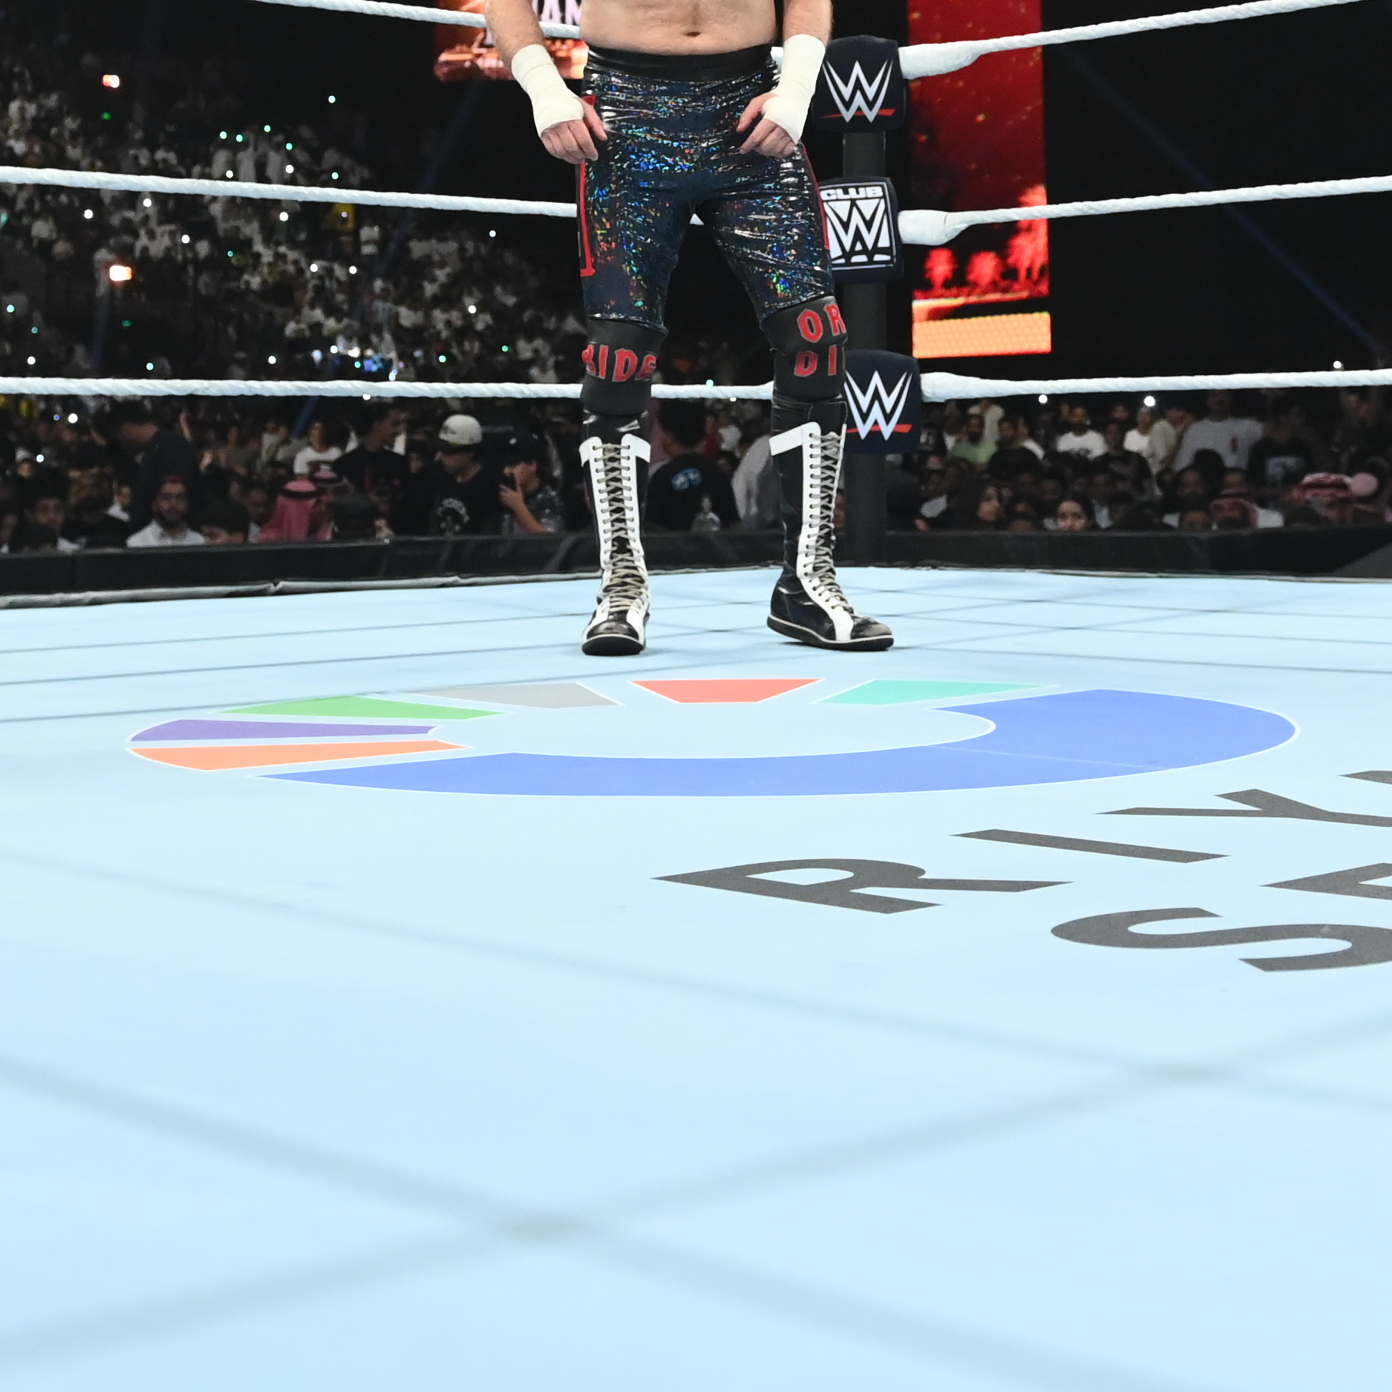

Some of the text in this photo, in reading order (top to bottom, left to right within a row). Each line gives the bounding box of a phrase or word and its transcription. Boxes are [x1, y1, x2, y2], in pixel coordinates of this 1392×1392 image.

[820, 186, 883, 201] CLUB
[797, 303, 847, 343] OR
[793, 344, 838, 377] DI
